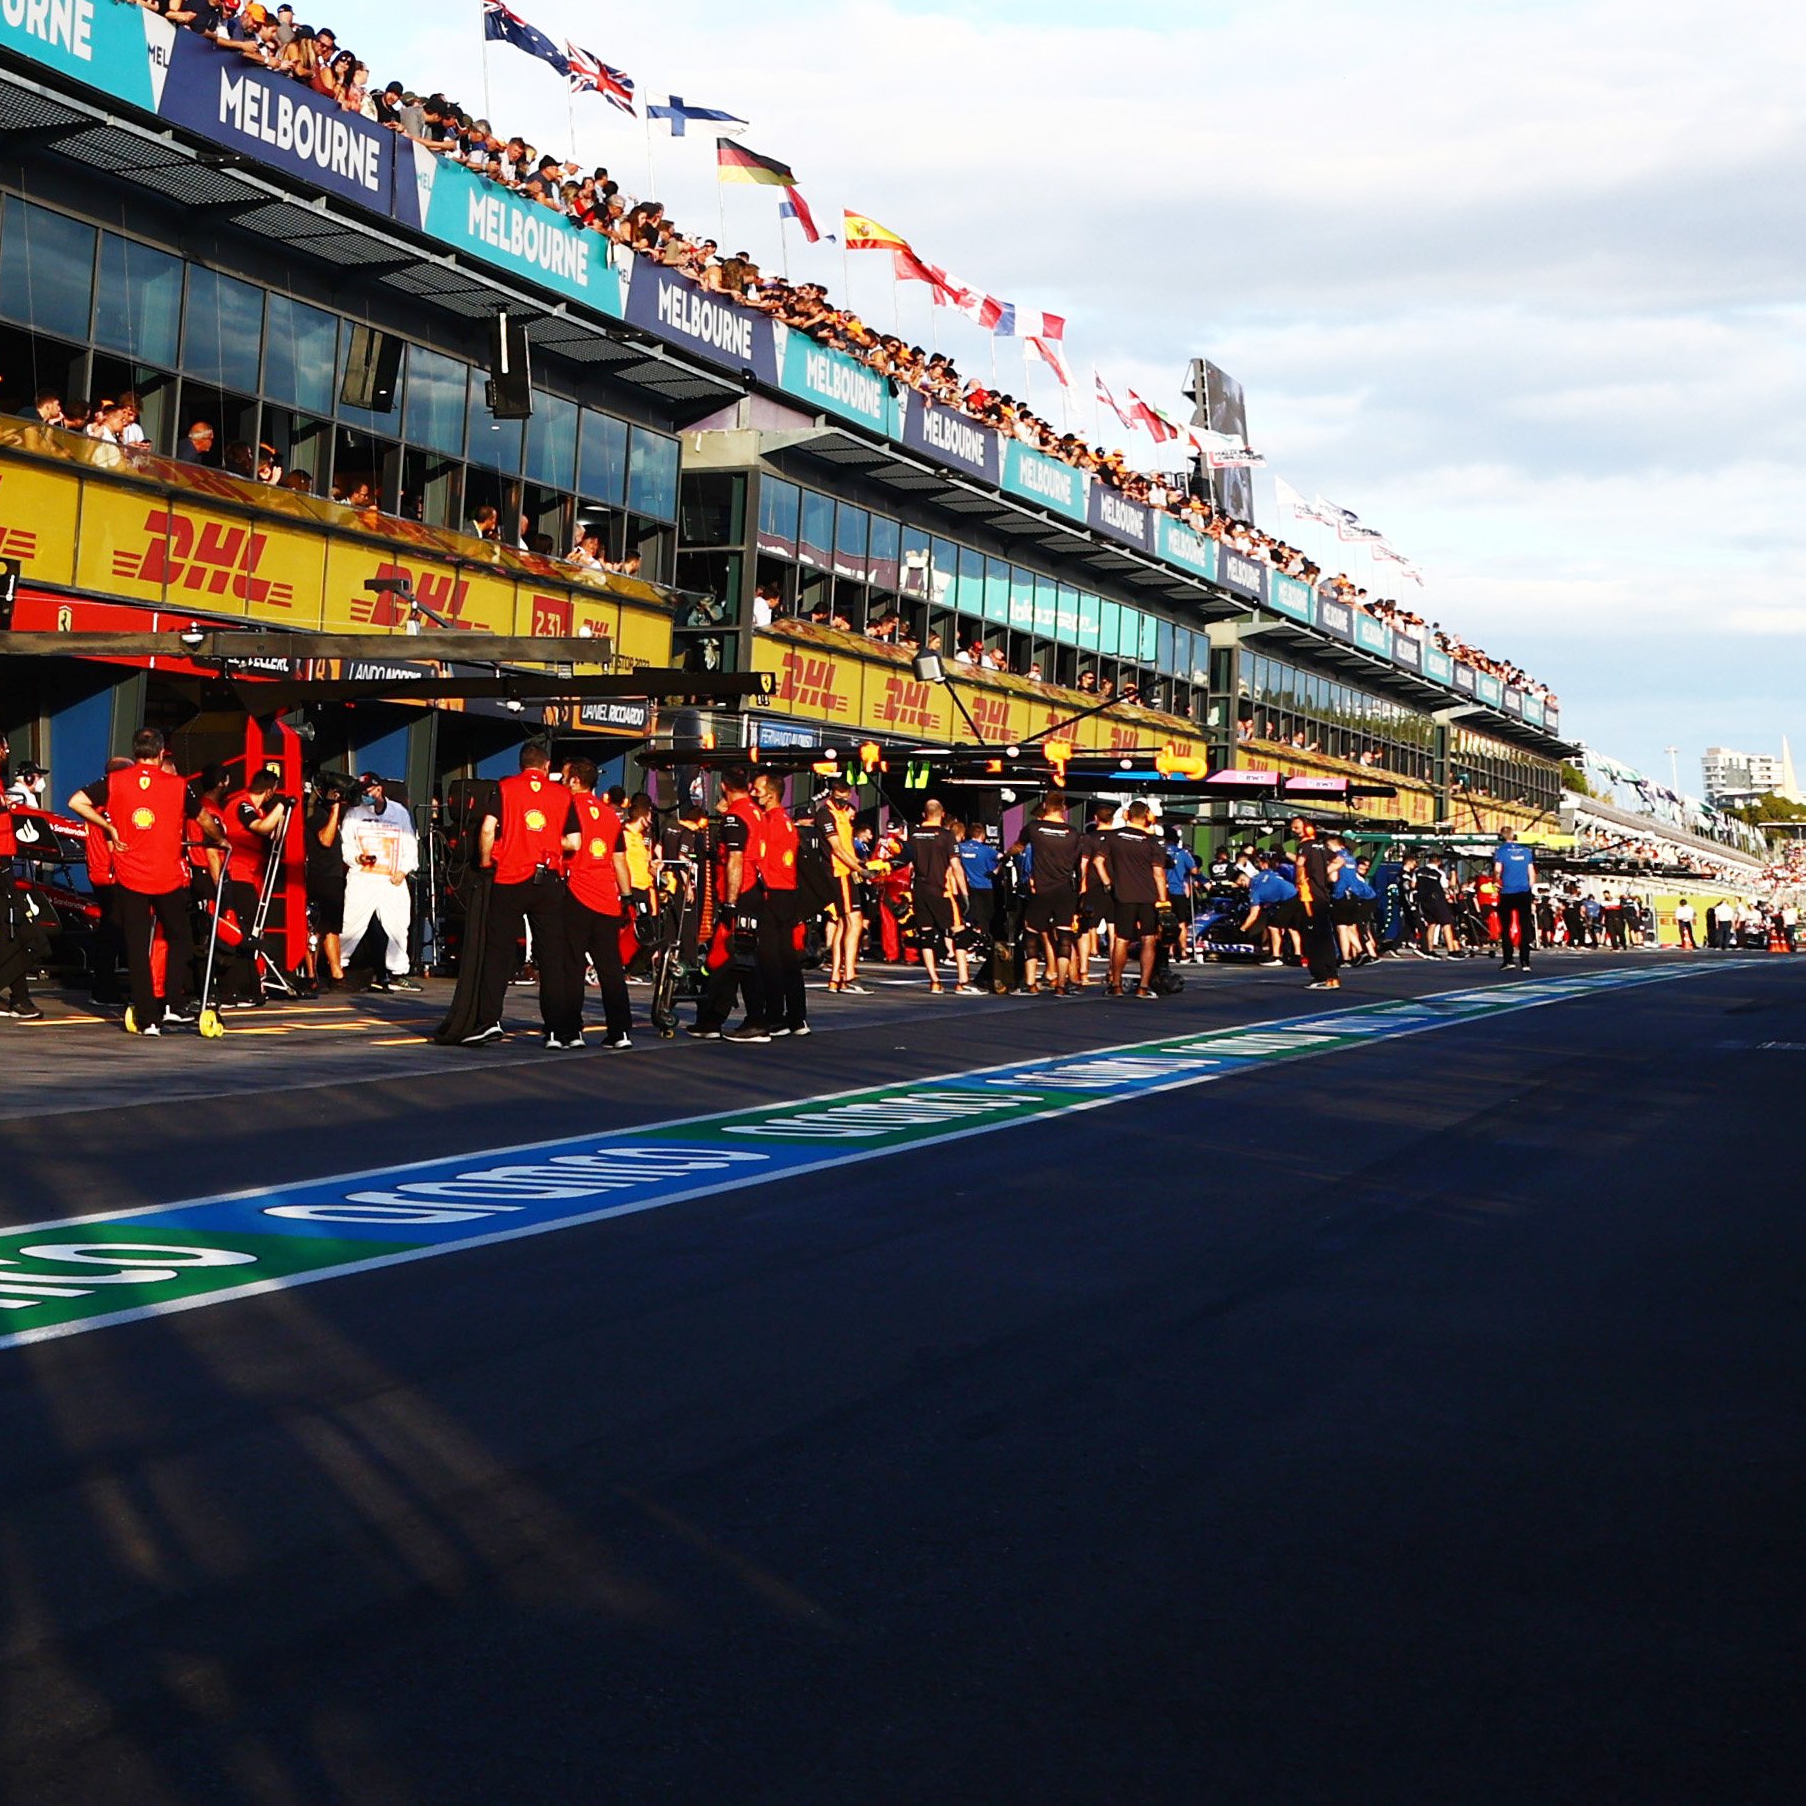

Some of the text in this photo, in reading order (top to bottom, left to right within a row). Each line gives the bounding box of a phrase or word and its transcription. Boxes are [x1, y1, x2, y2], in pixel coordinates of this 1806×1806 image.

[146, 40, 170, 67] MEL
[218, 65, 381, 192] MELBOURNE
[467, 186, 589, 288] MELBOURNE
[658, 277, 753, 361] MELBOURNE
[805, 349, 882, 420] MELBOURNE
[922, 406, 986, 468] MELBOURNE
[1019, 453, 1073, 507] MELBOURNE
[1100, 492, 1145, 541] MELBOURNE
[137, 510, 274, 607] DHL
[370, 560, 472, 629] DHL
[781, 652, 838, 710] DHL
[884, 678, 931, 727] DHL
[581, 704, 645, 726] DANIEL RICCIARDO
[760, 727, 791, 747] FERNANDO
[972, 697, 1013, 742] DHL
[721, 1091, 1045, 1138] aramco
[262, 1144, 758, 1225] aramco
